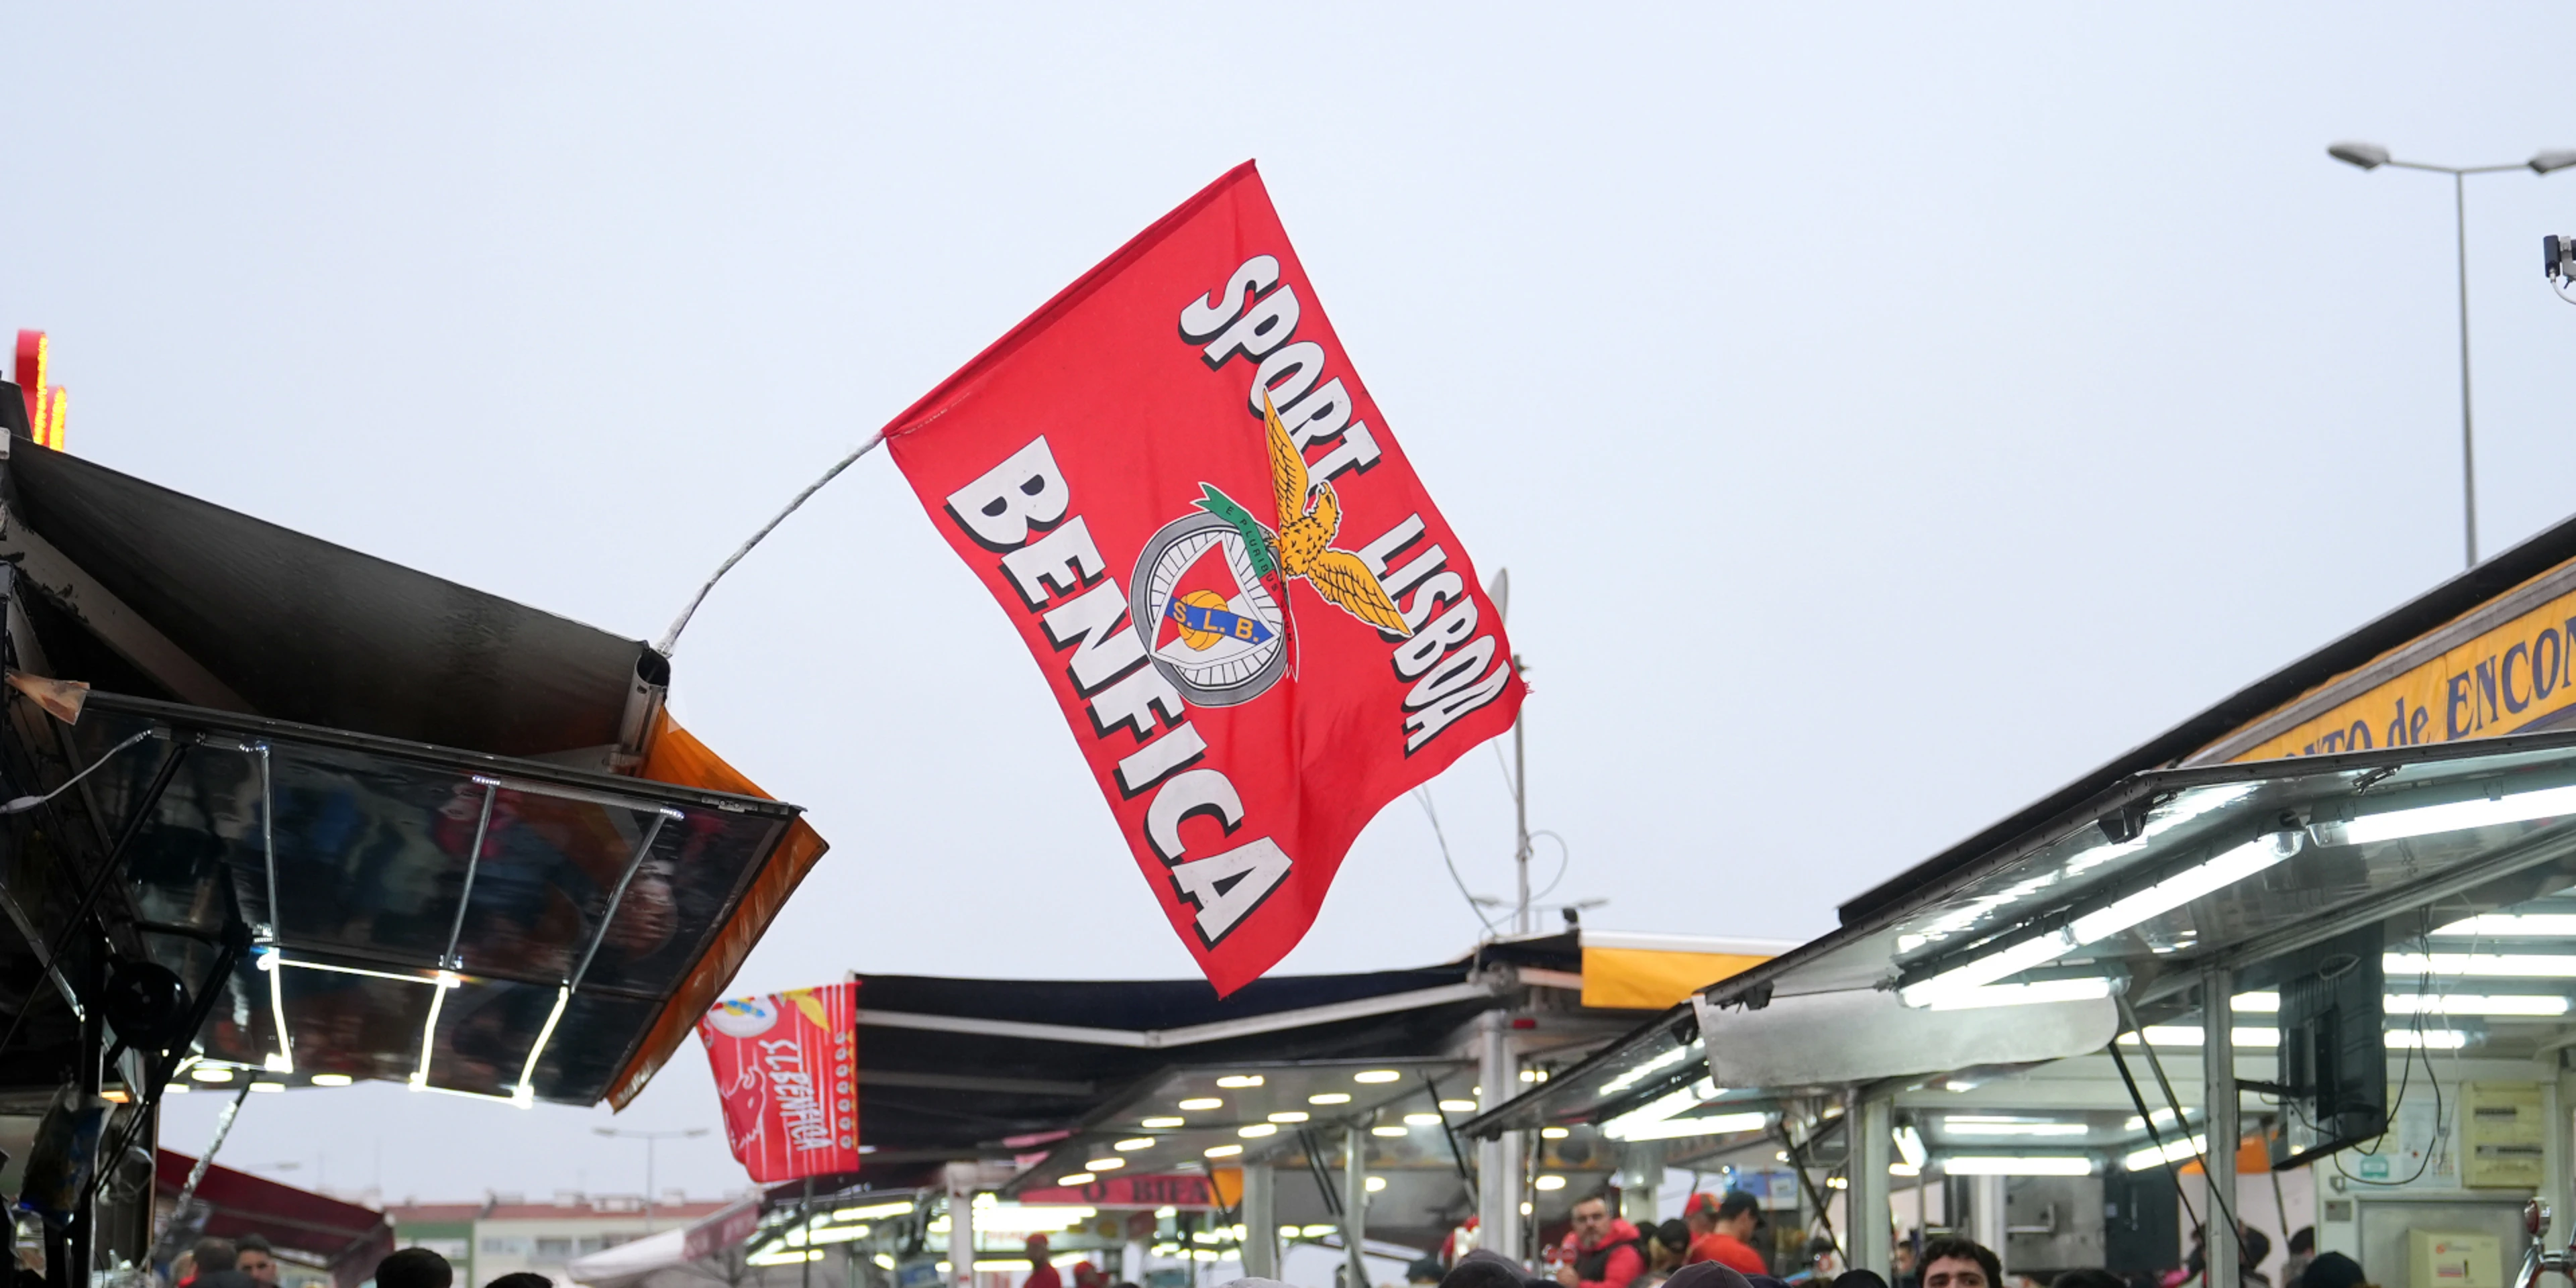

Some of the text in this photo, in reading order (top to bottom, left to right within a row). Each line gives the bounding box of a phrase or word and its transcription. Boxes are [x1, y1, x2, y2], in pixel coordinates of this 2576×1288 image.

[1178, 254, 1511, 759] SPORT LISBOA
[1239, 519, 1279, 592] PLURIBUS
[946, 433, 1293, 949] BENFICA
[2387, 698, 2430, 748] de
[769, 1072, 834, 1151] BENFICA
